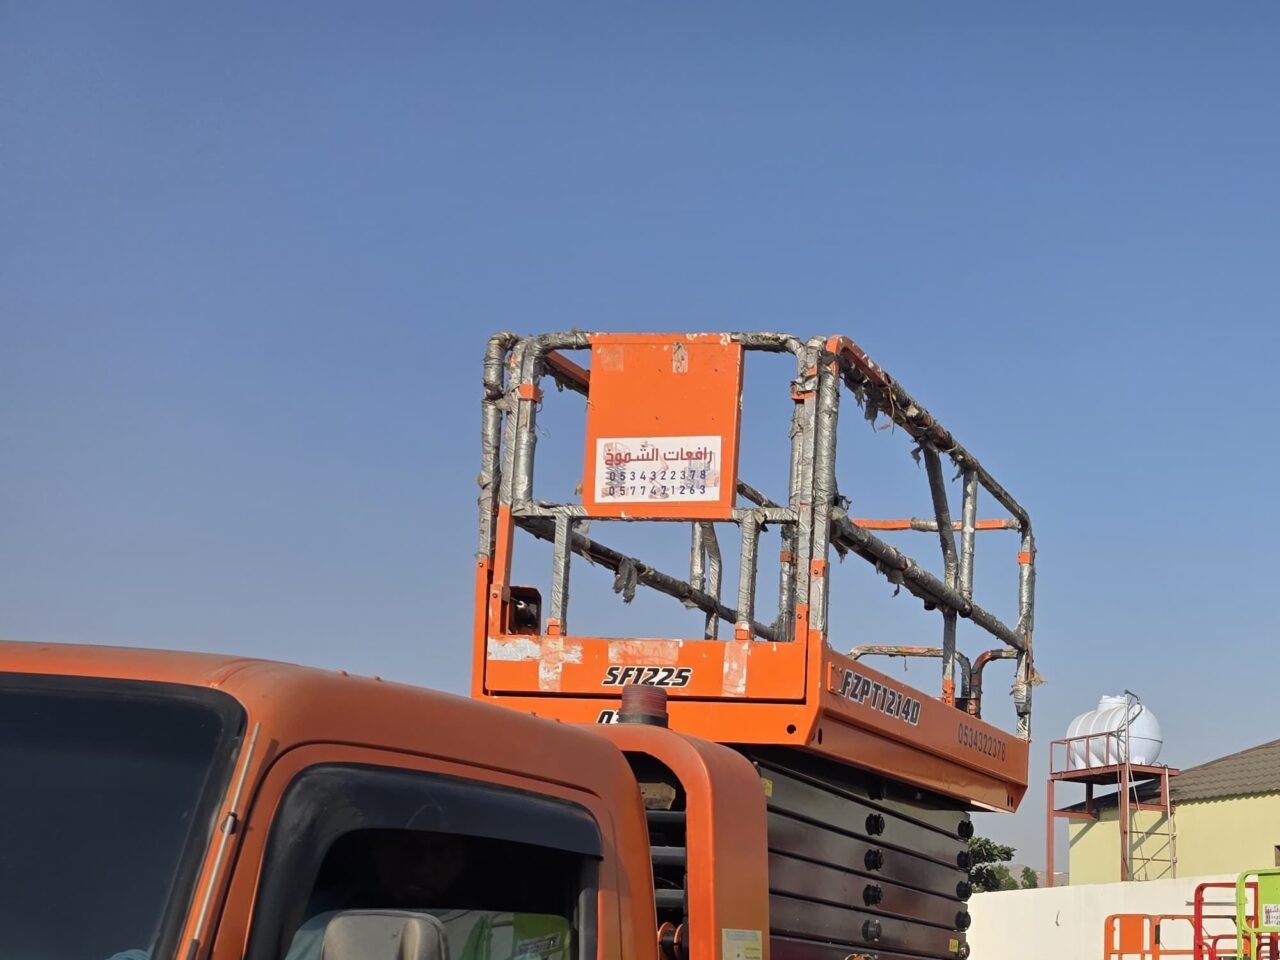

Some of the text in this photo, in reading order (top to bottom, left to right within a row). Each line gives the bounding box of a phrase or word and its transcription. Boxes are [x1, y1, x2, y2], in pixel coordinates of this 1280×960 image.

[663, 446, 713, 464] رافعات
[609, 470, 707, 481] 0534322378
[608, 485, 706, 496] 0577471263
[602, 666, 692, 687] SF1225
[958, 723, 1006, 762] 0534322378
